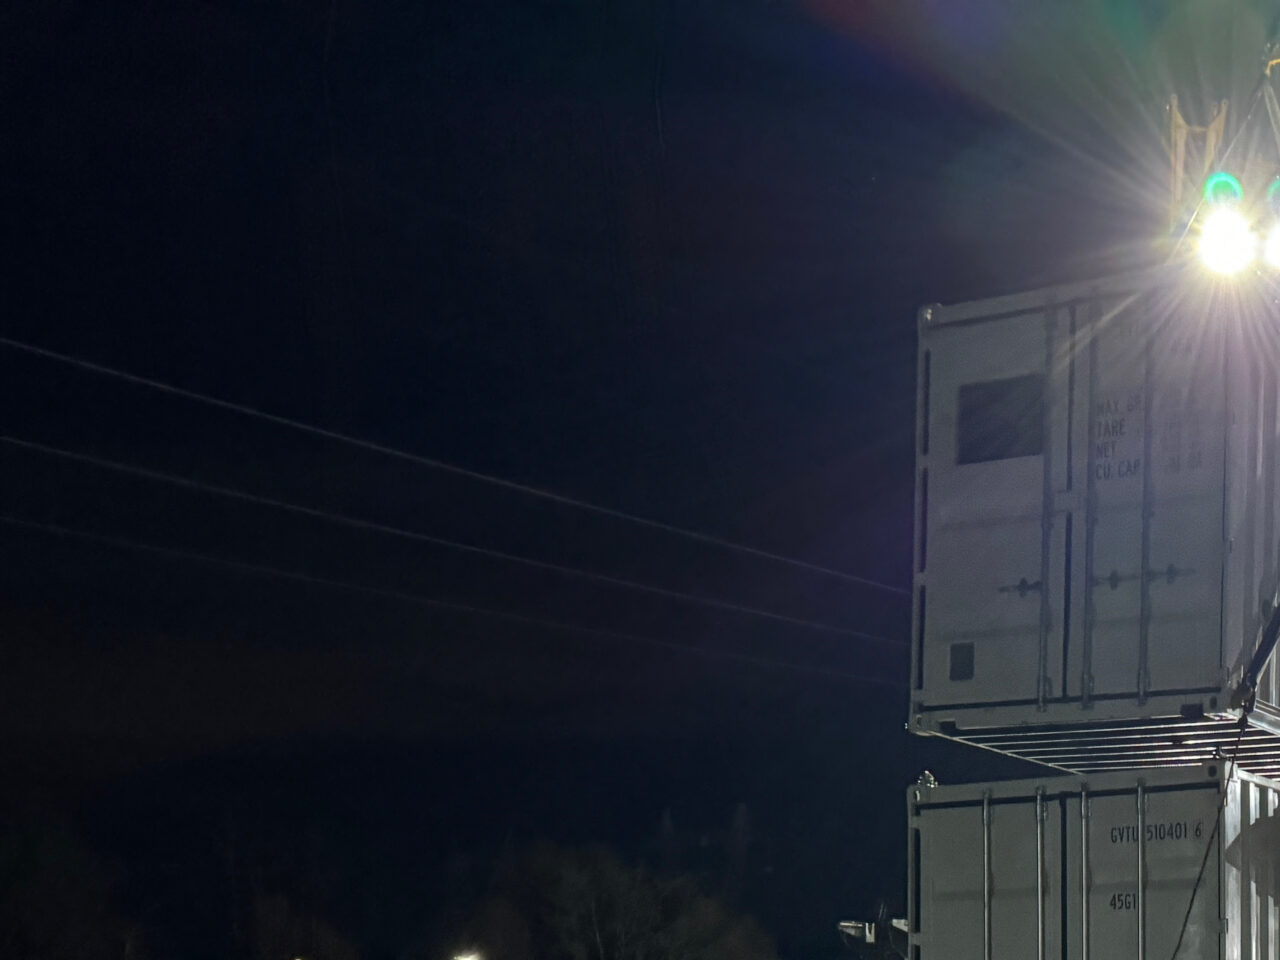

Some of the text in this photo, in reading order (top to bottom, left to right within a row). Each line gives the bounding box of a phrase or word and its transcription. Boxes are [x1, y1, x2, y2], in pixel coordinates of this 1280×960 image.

[1096, 418, 1126, 438] TARE
[1096, 440, 1116, 459] NET
[1111, 822, 1202, 843] GVTU 510401 6
[1109, 893, 1136, 911] 45G1
